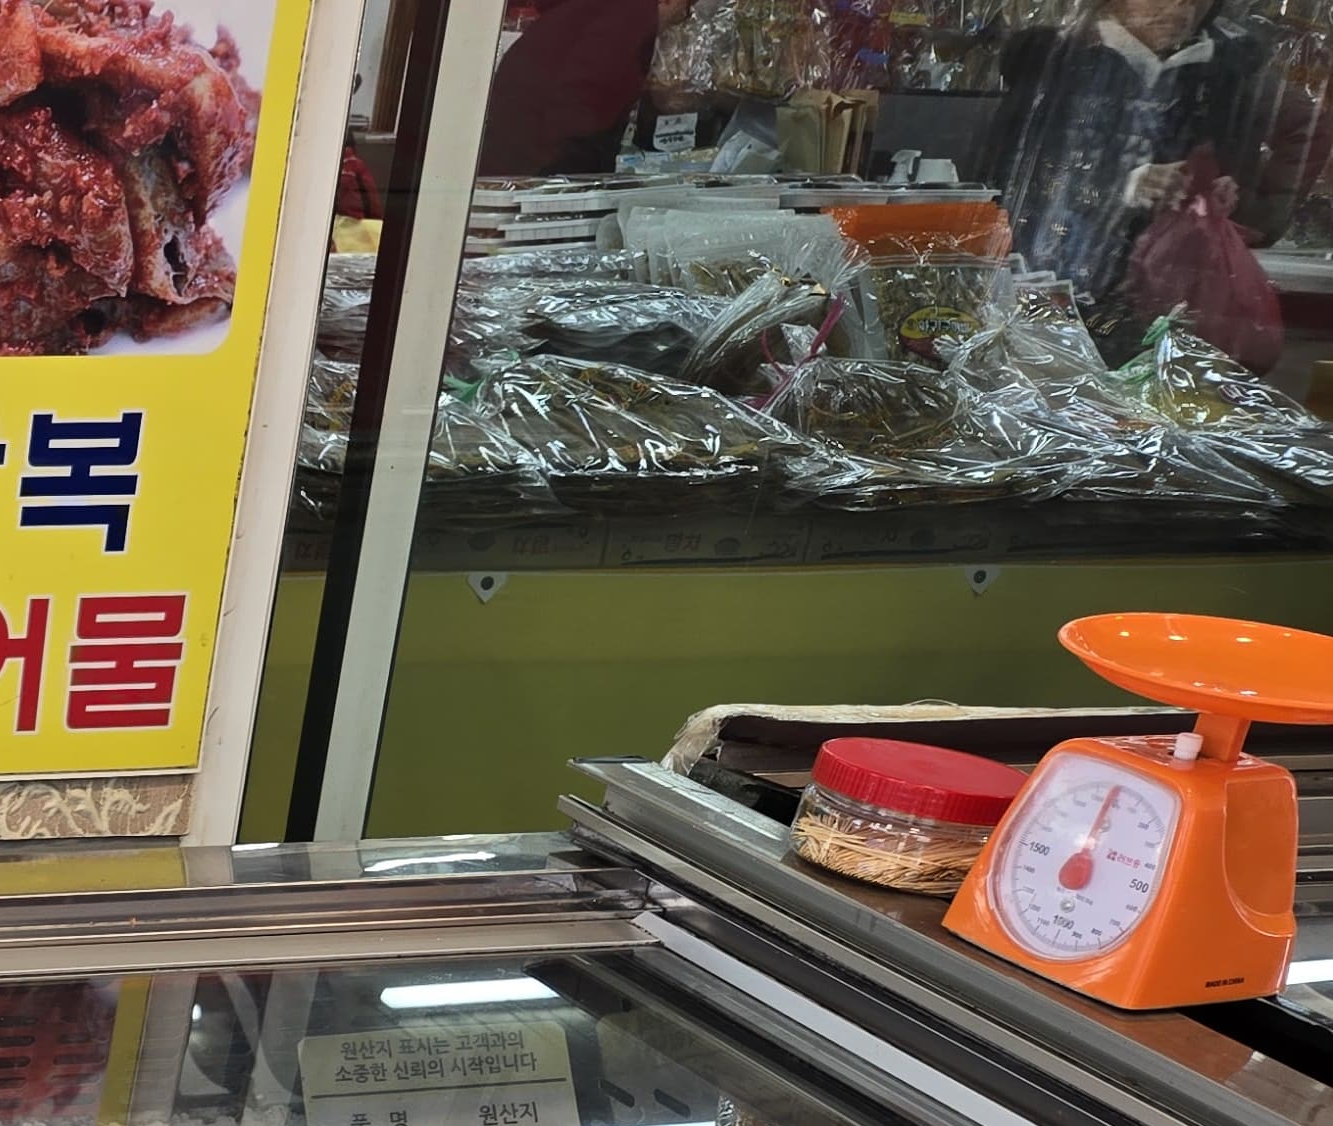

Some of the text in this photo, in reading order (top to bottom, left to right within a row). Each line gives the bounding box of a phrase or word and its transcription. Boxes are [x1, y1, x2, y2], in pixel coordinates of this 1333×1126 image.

[1029, 840, 1051, 857] 1500
[1128, 879, 1150, 894] 500
[341, 1030, 525, 1061] 원산지 표시는 고객과의
[335, 1052, 537, 1083] 소중한 신뢰의 시작입니다
[479, 1101, 539, 1126] 원산지
